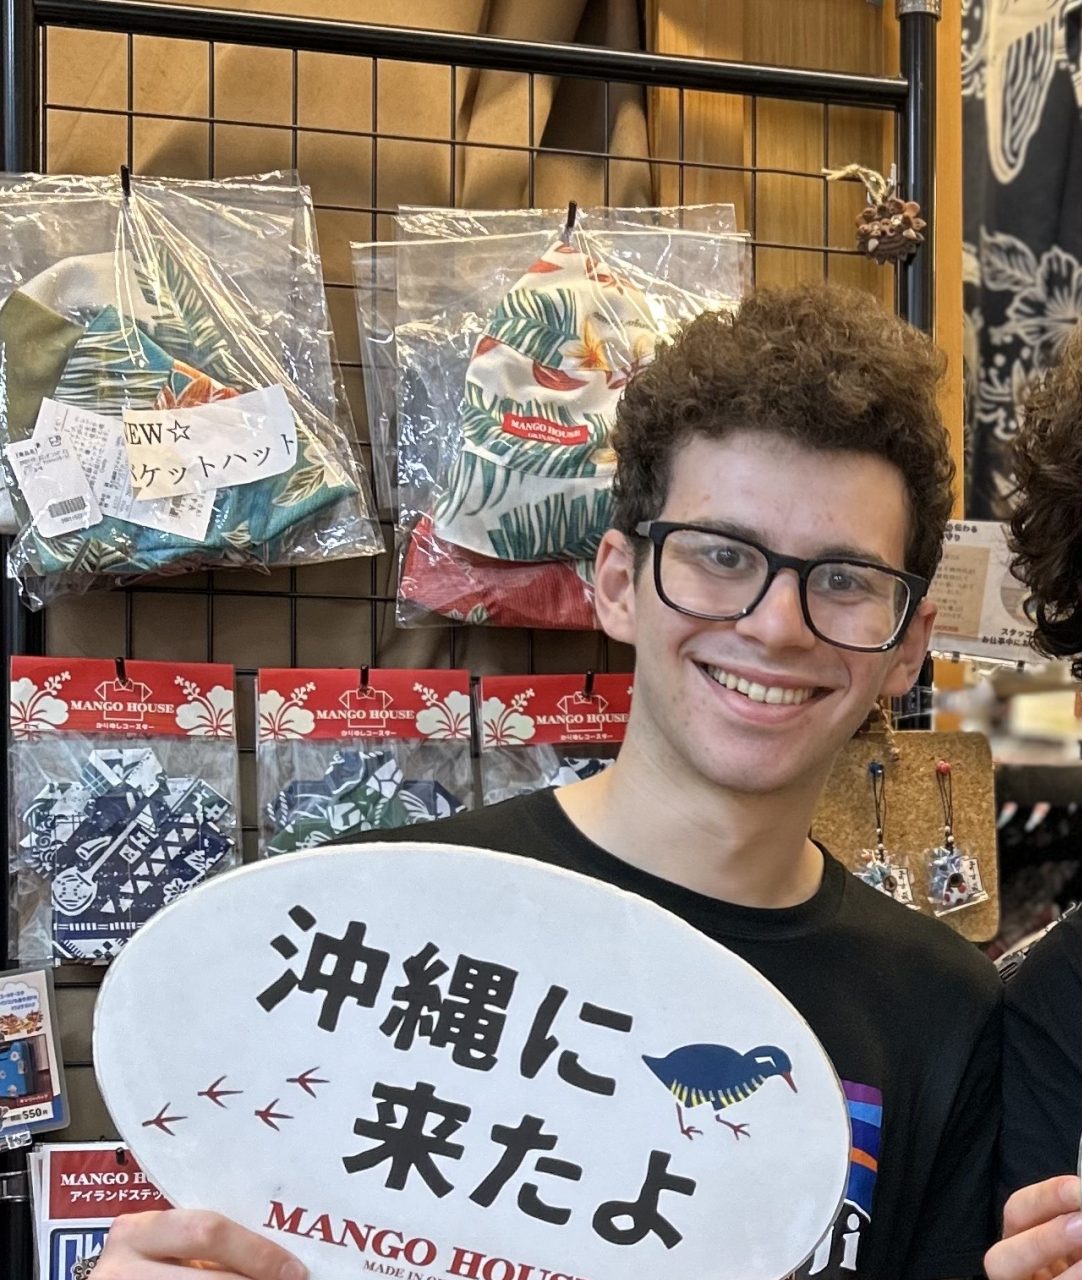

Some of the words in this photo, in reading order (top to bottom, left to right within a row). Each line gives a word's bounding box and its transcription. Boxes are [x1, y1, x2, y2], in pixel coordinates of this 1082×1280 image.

[511, 420, 547, 432] MANGO
[70, 700, 123, 711] MANGO
[127, 702, 174, 713] HOUSE
[316, 710, 366, 719] MANGO
[369, 710, 415, 719] HOUSE
[536, 714, 584, 725] MANGO
[257, 906, 632, 1095] 沖縄に
[343, 1082, 696, 1250] 来たよ
[60, 1173, 129, 1186] MANGO
[70, 1189, 168, 1202] アイランドステッ
[263, 1200, 437, 1266] MANGO
[363, 1259, 405, 1279] MADE
